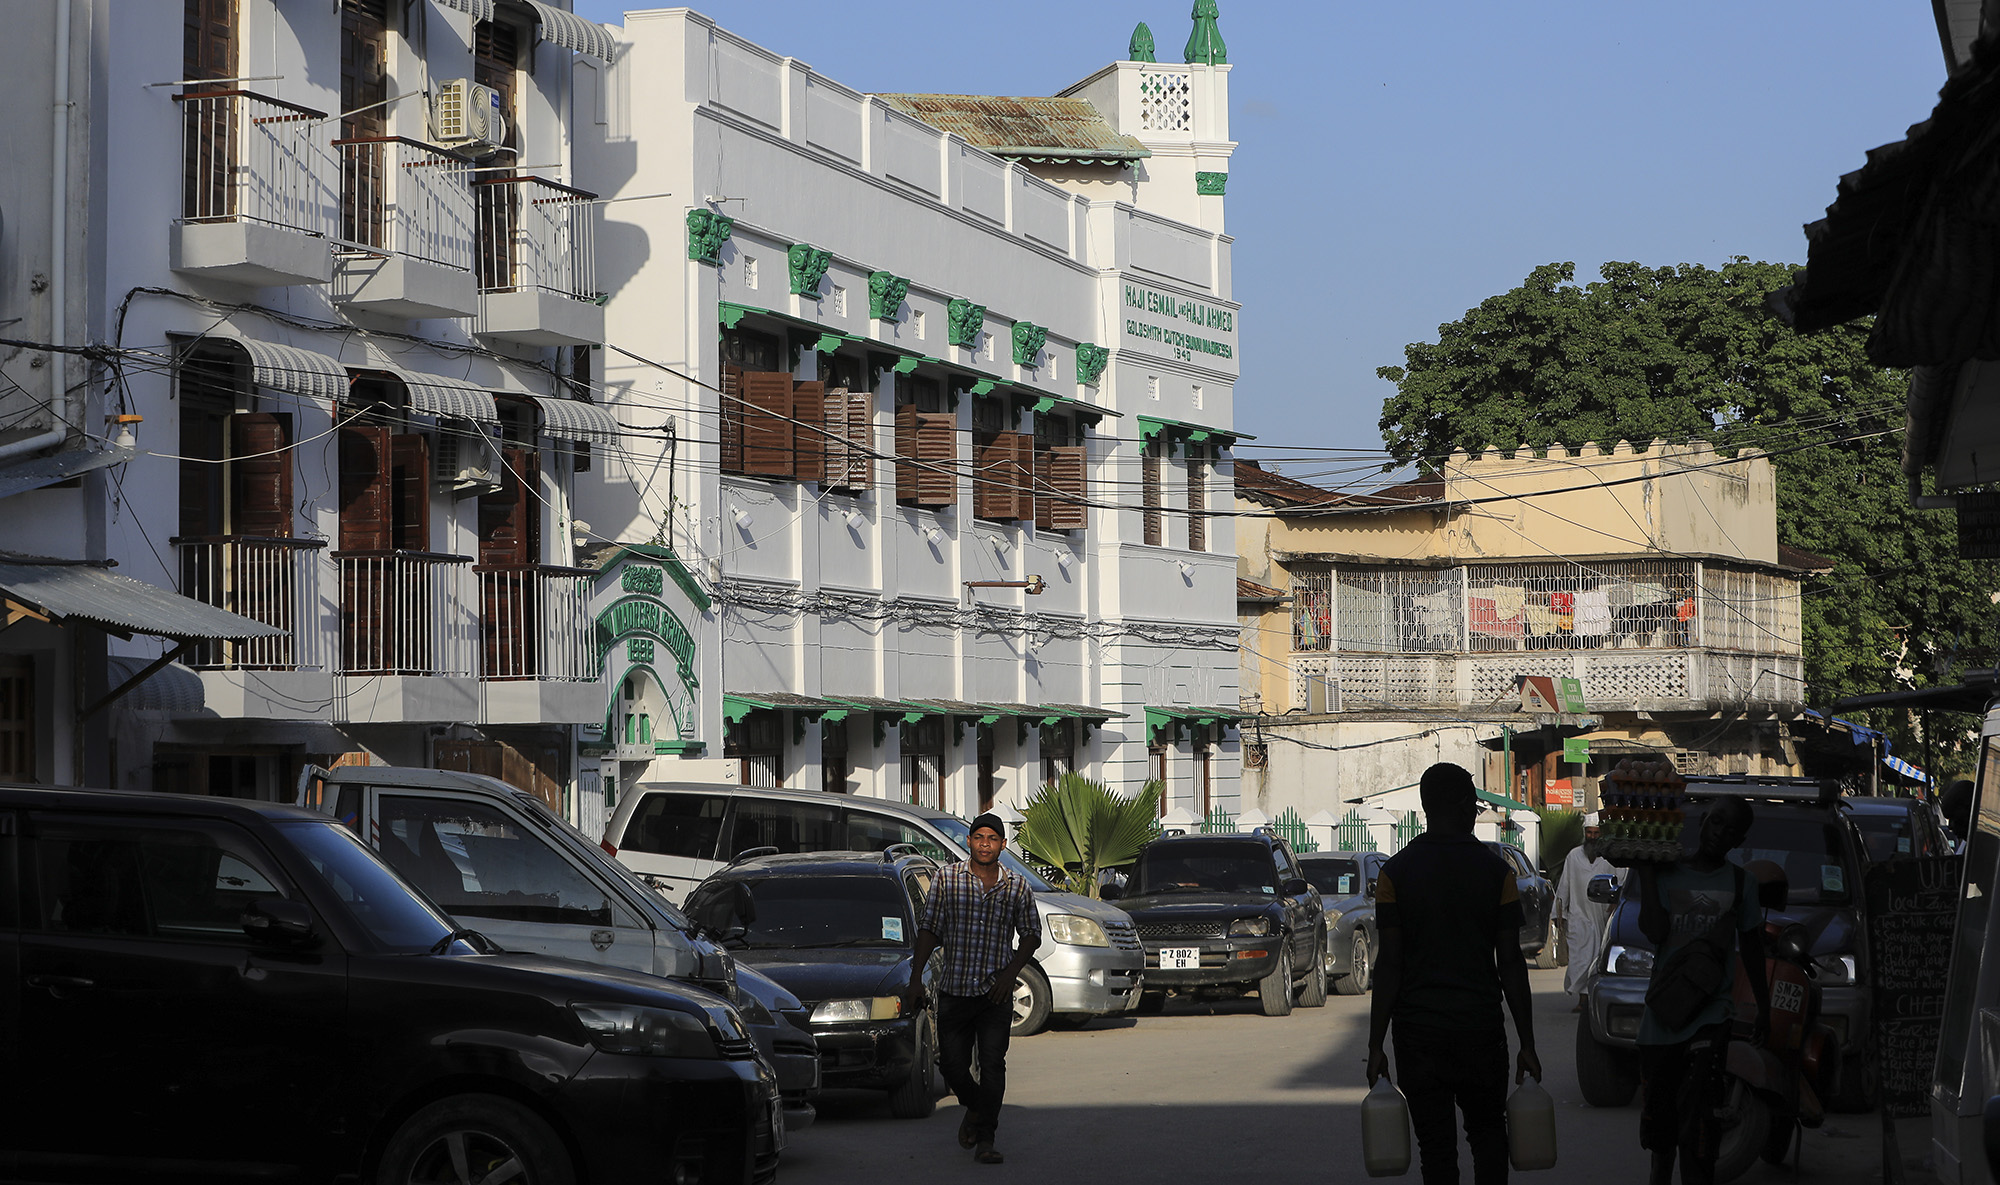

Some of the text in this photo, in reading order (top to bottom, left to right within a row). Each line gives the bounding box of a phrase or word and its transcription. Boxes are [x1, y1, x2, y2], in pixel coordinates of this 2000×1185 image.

[1125, 285, 1145, 310] HAJI
[1147, 290, 1178, 318] ESMAIL
[1186, 301, 1205, 326] HAJI
[1206, 307, 1233, 332] AHMED
[1126, 319, 1162, 342] GOLDSMITH
[612, 601, 660, 637] MADRESSA
[660, 611, 691, 664] SCHOOL
[1169, 949, 1192, 958] Z 802
[1776, 981, 1799, 998] SMZ
[1774, 994, 1799, 1012] 7242
